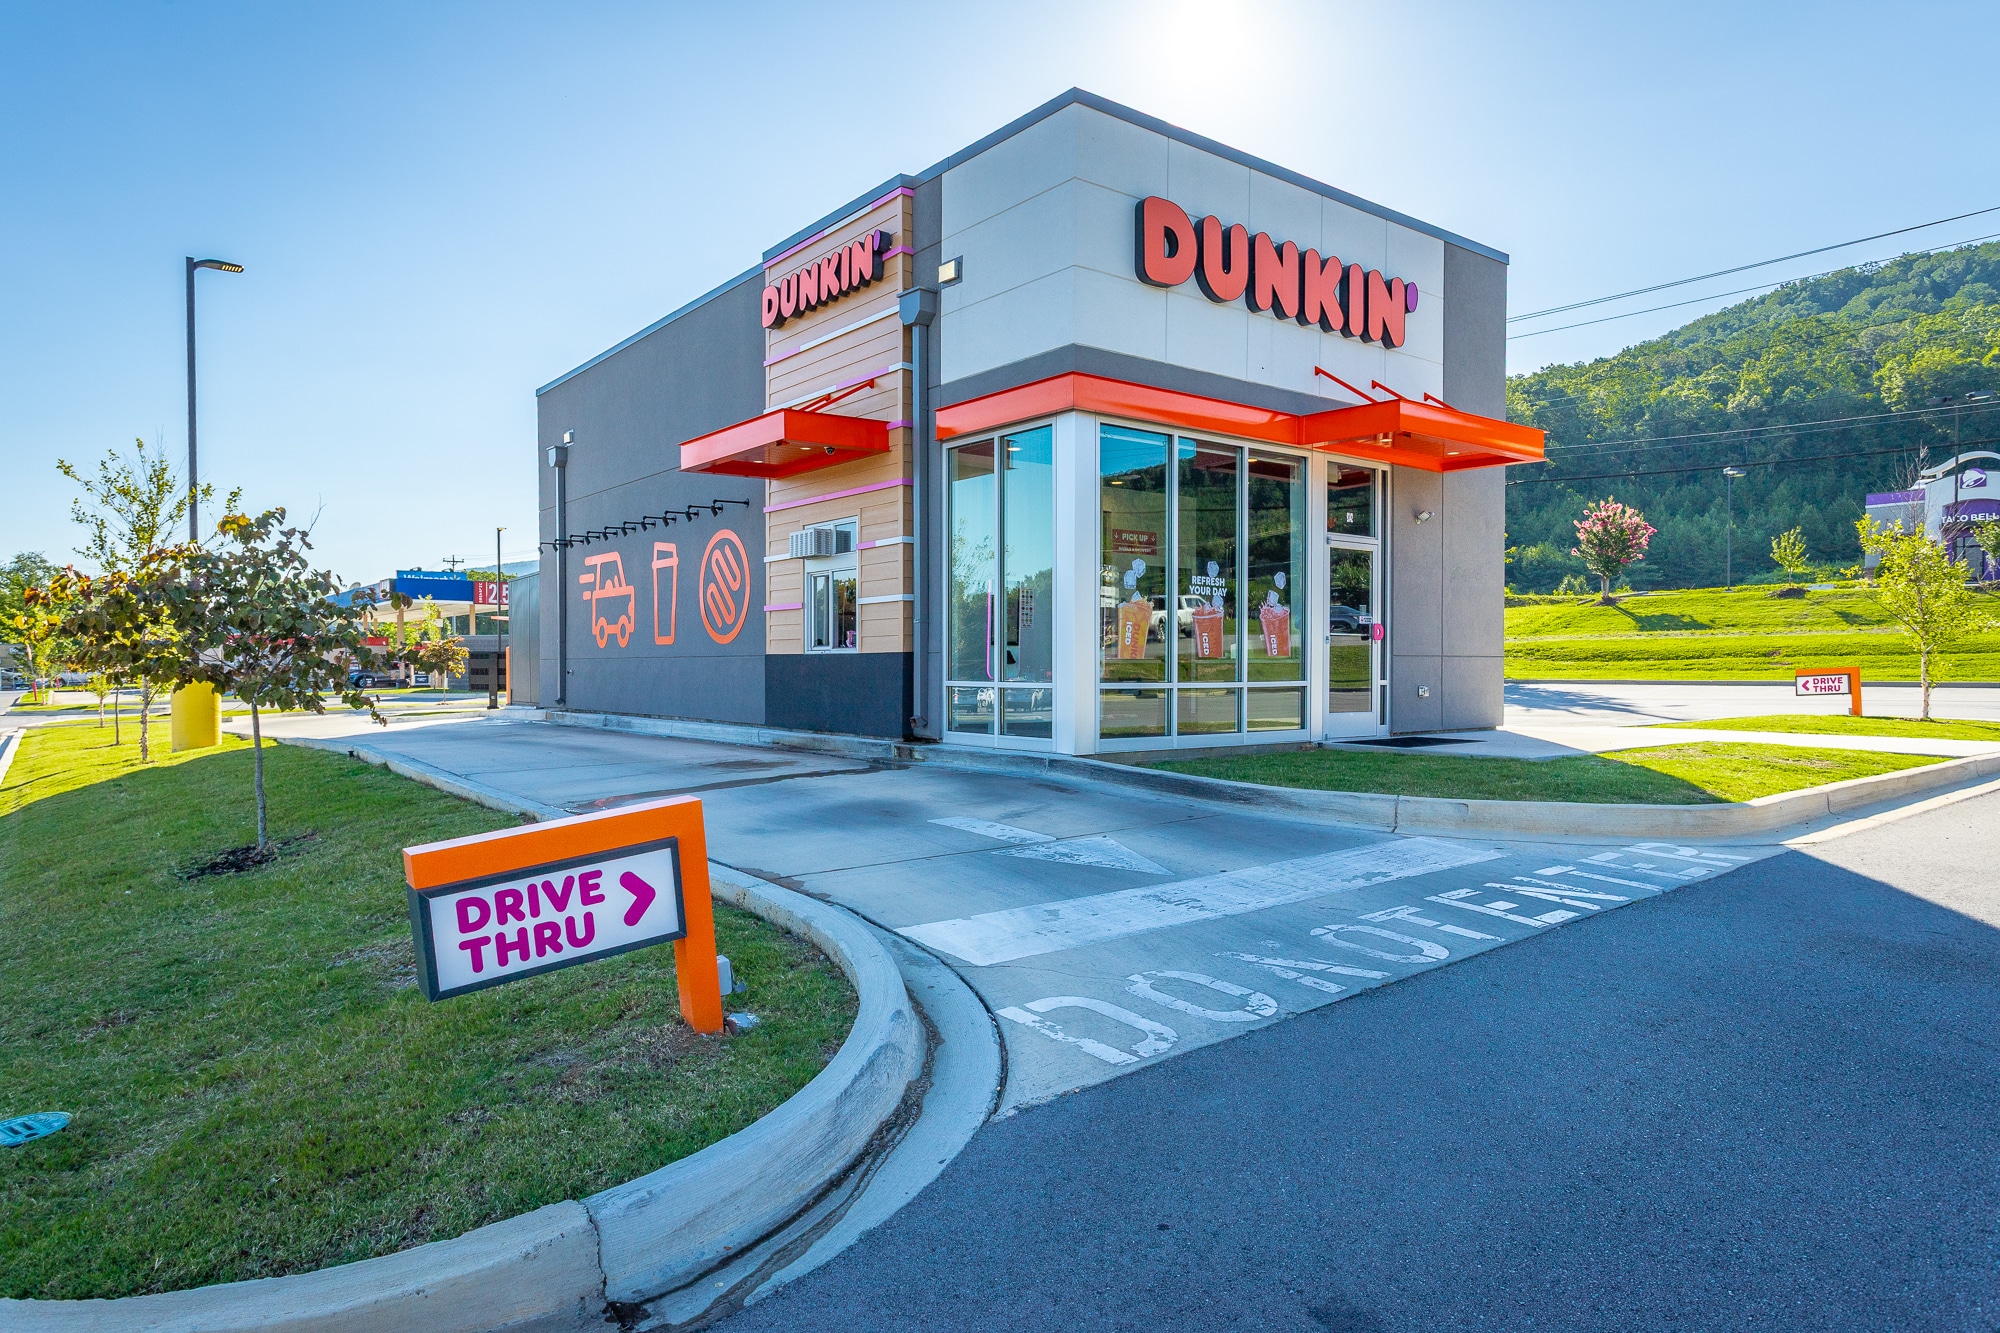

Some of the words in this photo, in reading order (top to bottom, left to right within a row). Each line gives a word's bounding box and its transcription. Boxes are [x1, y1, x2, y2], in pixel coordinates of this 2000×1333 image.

[761, 229, 885, 329] DUNKIN'
[1136, 196, 1418, 348] DUNKIN'
[1941, 514, 1969, 524] TACO
[1970, 512, 2000, 522] BELL
[1121, 533, 1138, 541] PICK
[1139, 534, 1149, 542] UP
[1189, 585, 1211, 596] YOUR
[1212, 587, 1228, 597] DAY
[1191, 575, 1226, 587] REFRESH
[1125, 621, 1133, 646] ICED
[1202, 632, 1210, 656] ICED
[1270, 634, 1278, 656] ICED
[1813, 676, 1843, 685] DRIVE
[1813, 684, 1841, 693] THRU
[456, 869, 606, 934] DRIVE
[458, 911, 596, 974] THRU
[995, 966, 1278, 1066] DO
[1211, 904, 1505, 994] NOT
[1423, 841, 1753, 929] ENTER
